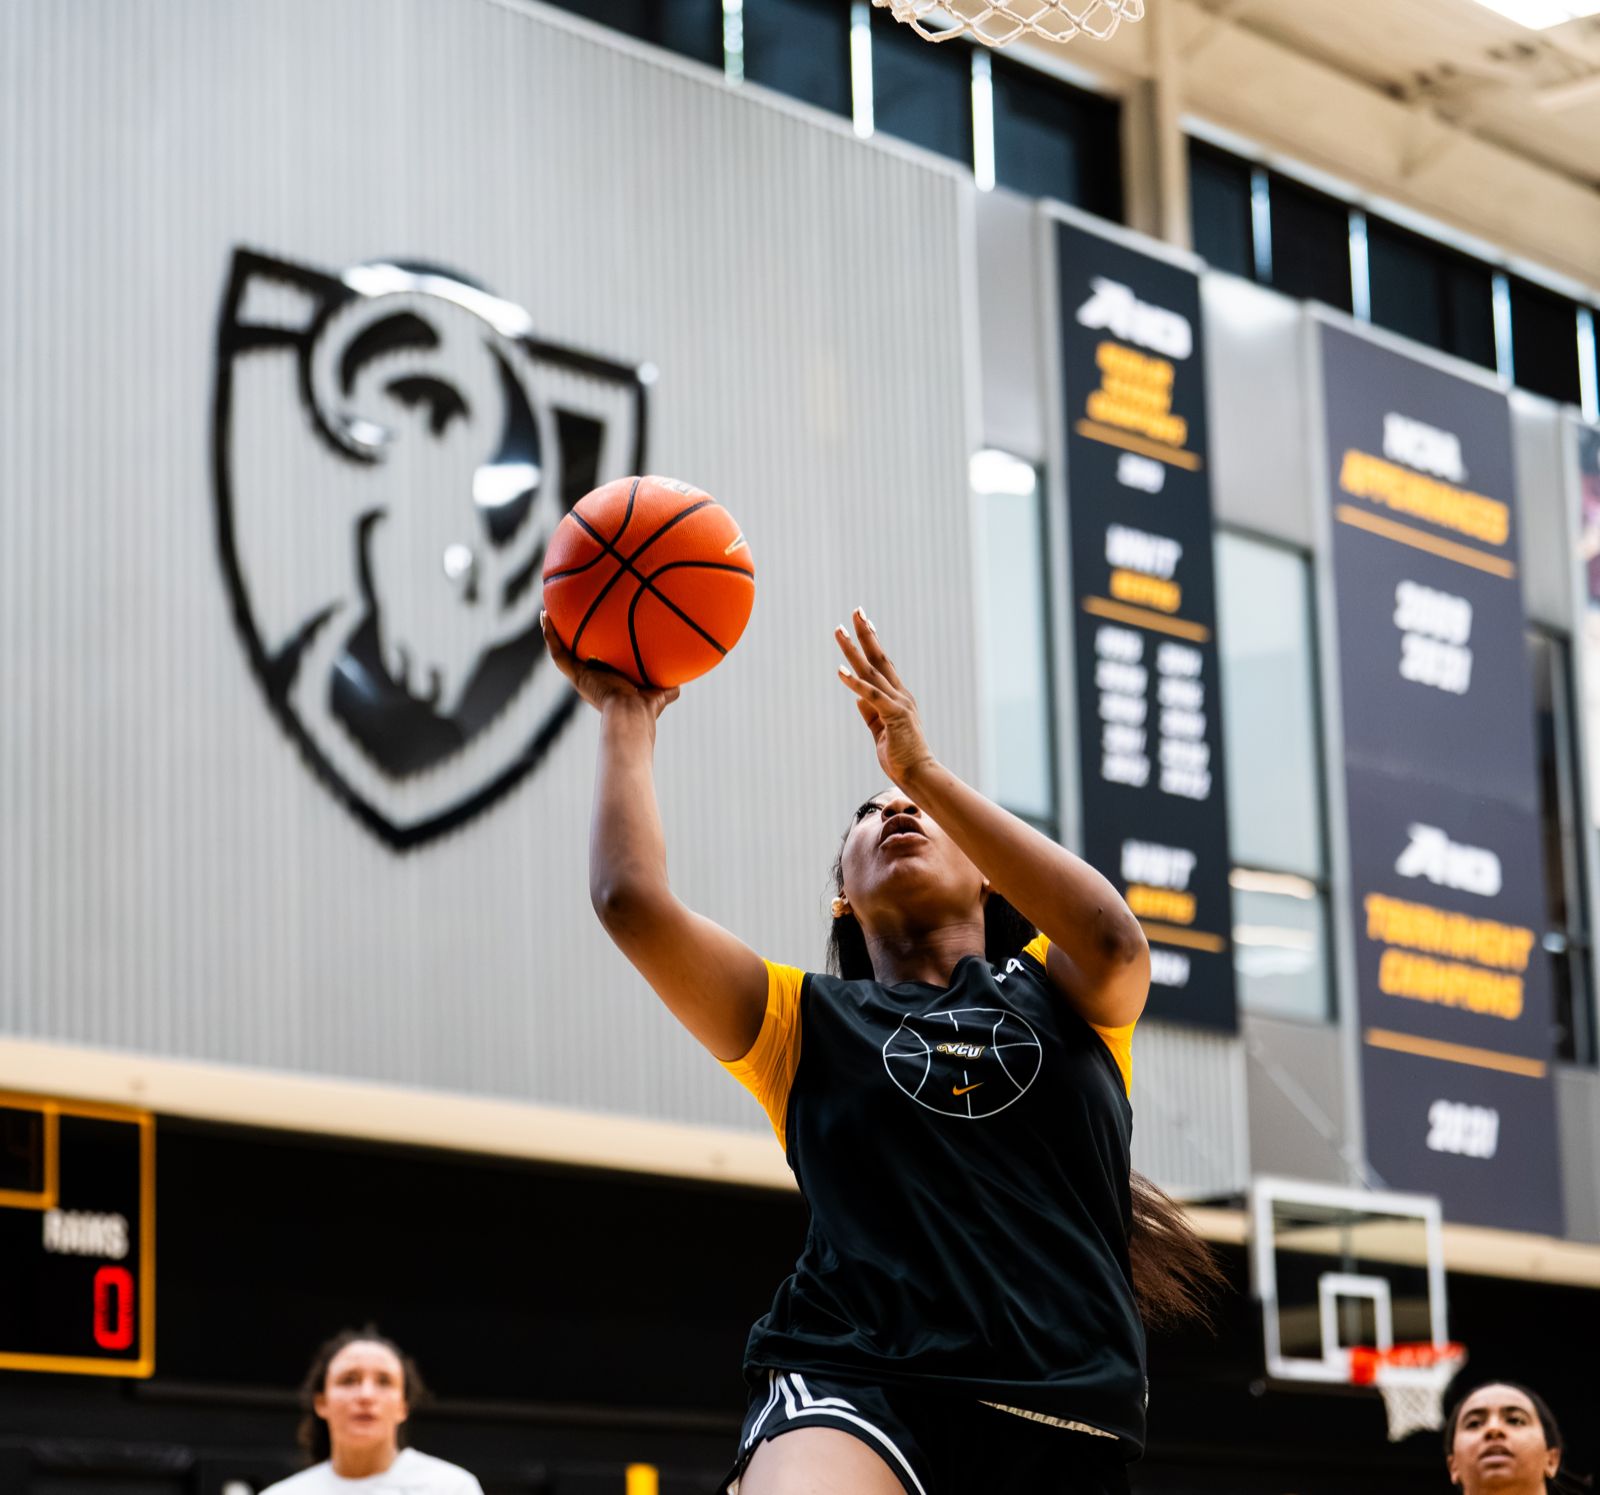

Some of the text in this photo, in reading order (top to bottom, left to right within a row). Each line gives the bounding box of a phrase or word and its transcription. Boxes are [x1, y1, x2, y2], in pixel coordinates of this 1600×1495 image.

[1365, 894, 1534, 972] TOURNAMENT
[1380, 950, 1523, 1020] CHAMPIONS
[946, 1043, 985, 1060] VCU
[44, 1210, 128, 1259] RAMS
[94, 1266, 133, 1349] 0
